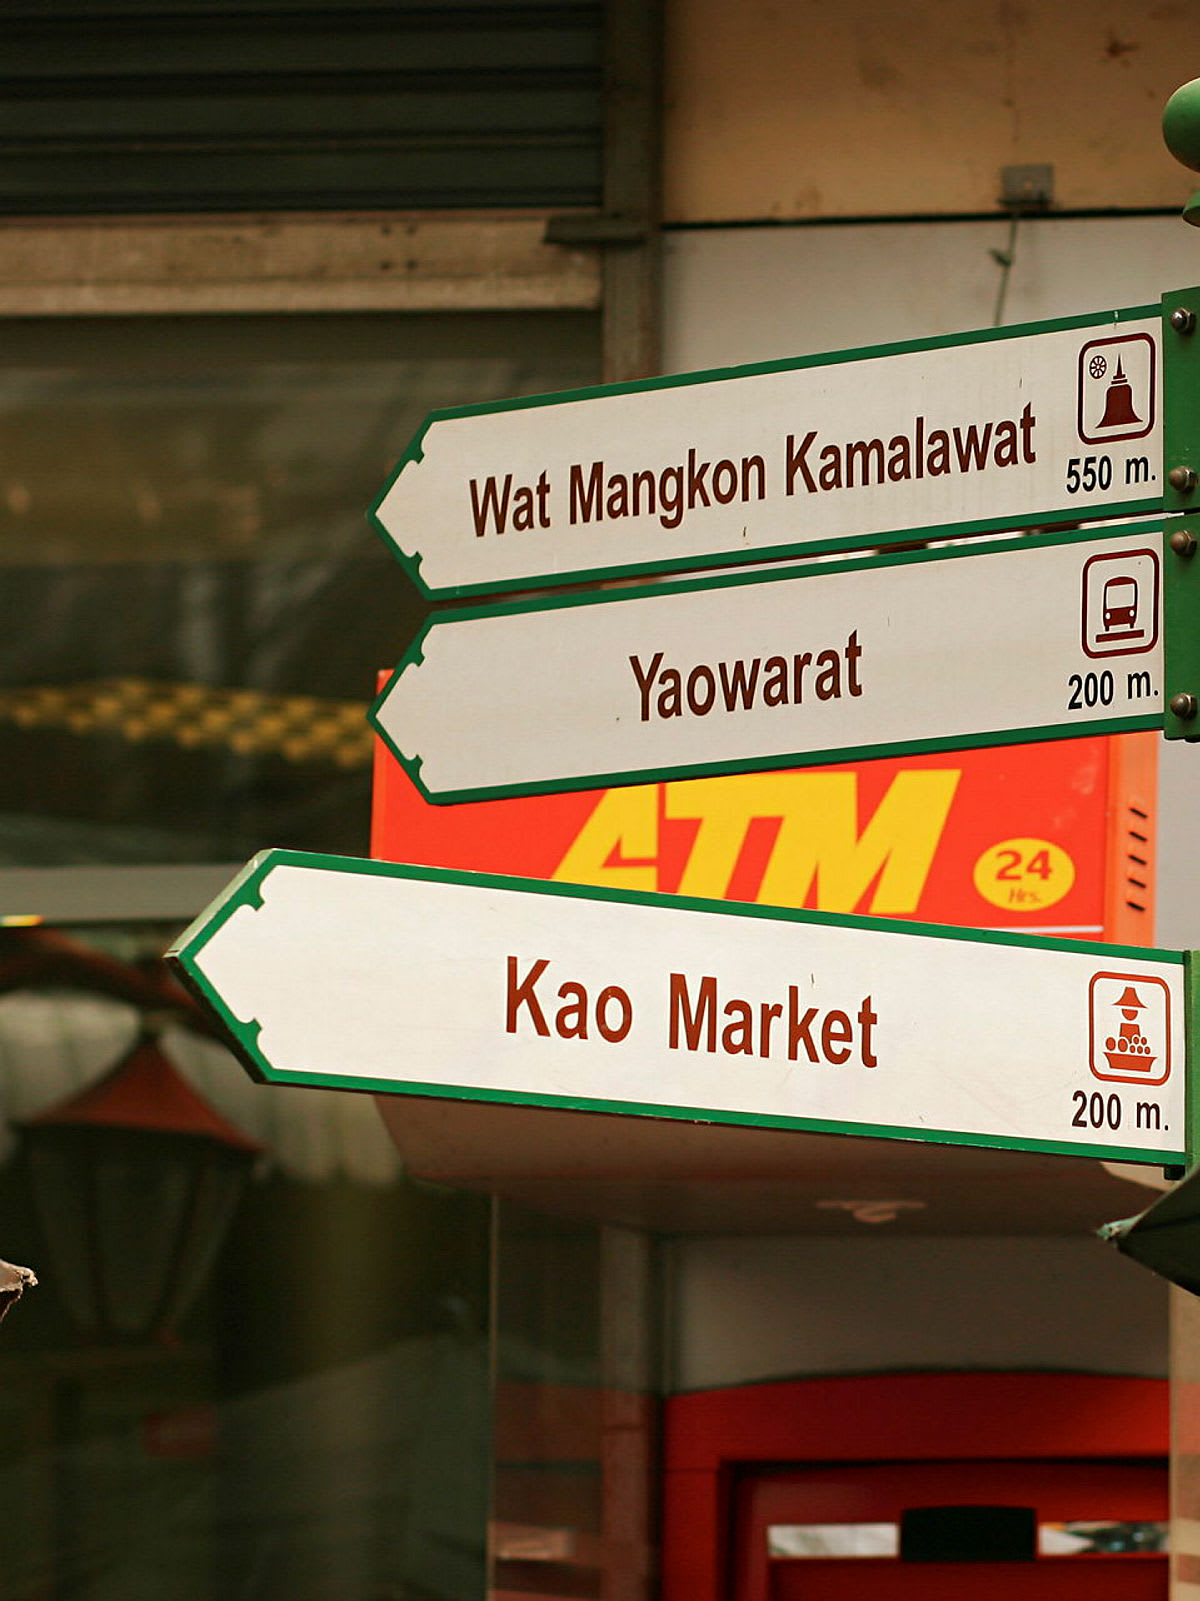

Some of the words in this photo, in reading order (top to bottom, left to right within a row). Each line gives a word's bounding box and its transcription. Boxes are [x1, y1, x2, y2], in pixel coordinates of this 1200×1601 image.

[470, 470, 551, 538] Wat
[569, 449, 766, 530] Mangkon
[785, 402, 1037, 497] Kamalawat
[1066, 456, 1113, 495] 550
[1125, 456, 1158, 485] m.
[629, 630, 863, 722] Yaowarat
[1067, 669, 1114, 711] 200
[1127, 671, 1161, 700] m.
[546, 769, 961, 915] ATM
[995, 849, 1052, 881] 24
[506, 956, 633, 1044] Kao
[668, 972, 878, 1070] Market
[1071, 1090, 1122, 1130] 200
[1136, 1102, 1169, 1131] m.
